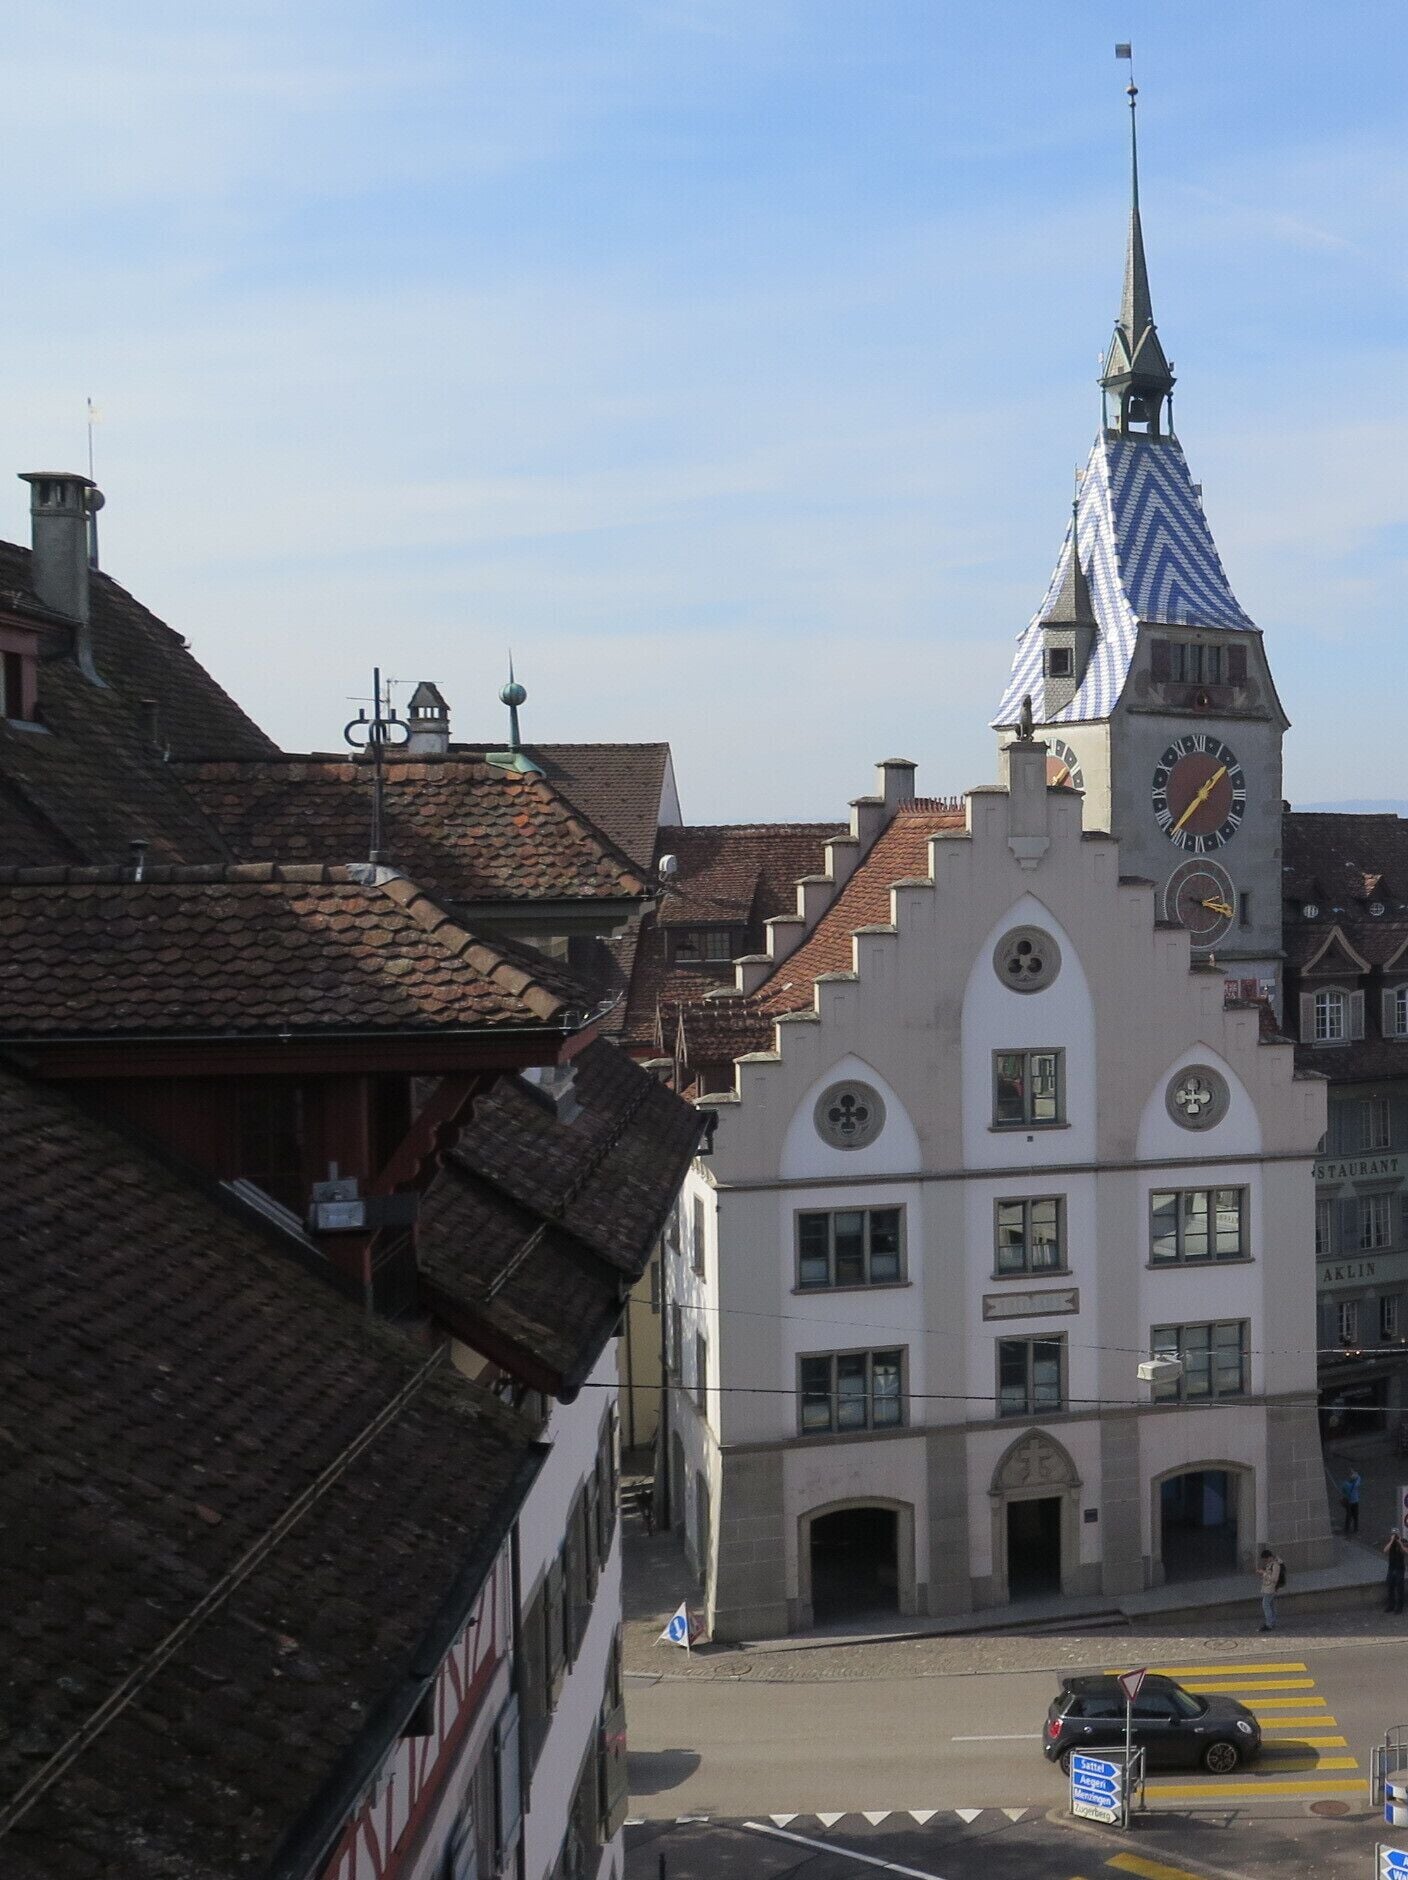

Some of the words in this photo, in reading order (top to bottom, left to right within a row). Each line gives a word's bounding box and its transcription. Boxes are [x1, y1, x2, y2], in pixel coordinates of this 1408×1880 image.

[1171, 739, 1187, 760] XI
[1191, 734, 1207, 752] XII
[1156, 760, 1173, 775] X
[1227, 763, 1241, 777] II
[1232, 788, 1246, 801] III
[1215, 829, 1227, 848] V
[1323, 1262, 1376, 1282] AKLIN
[1080, 1759, 1105, 1773] Sattel
[1079, 1774, 1107, 1789] Aegeri
[1074, 1788, 1112, 1806] Menzingen
[1074, 1803, 1111, 1823] Zugerberg
